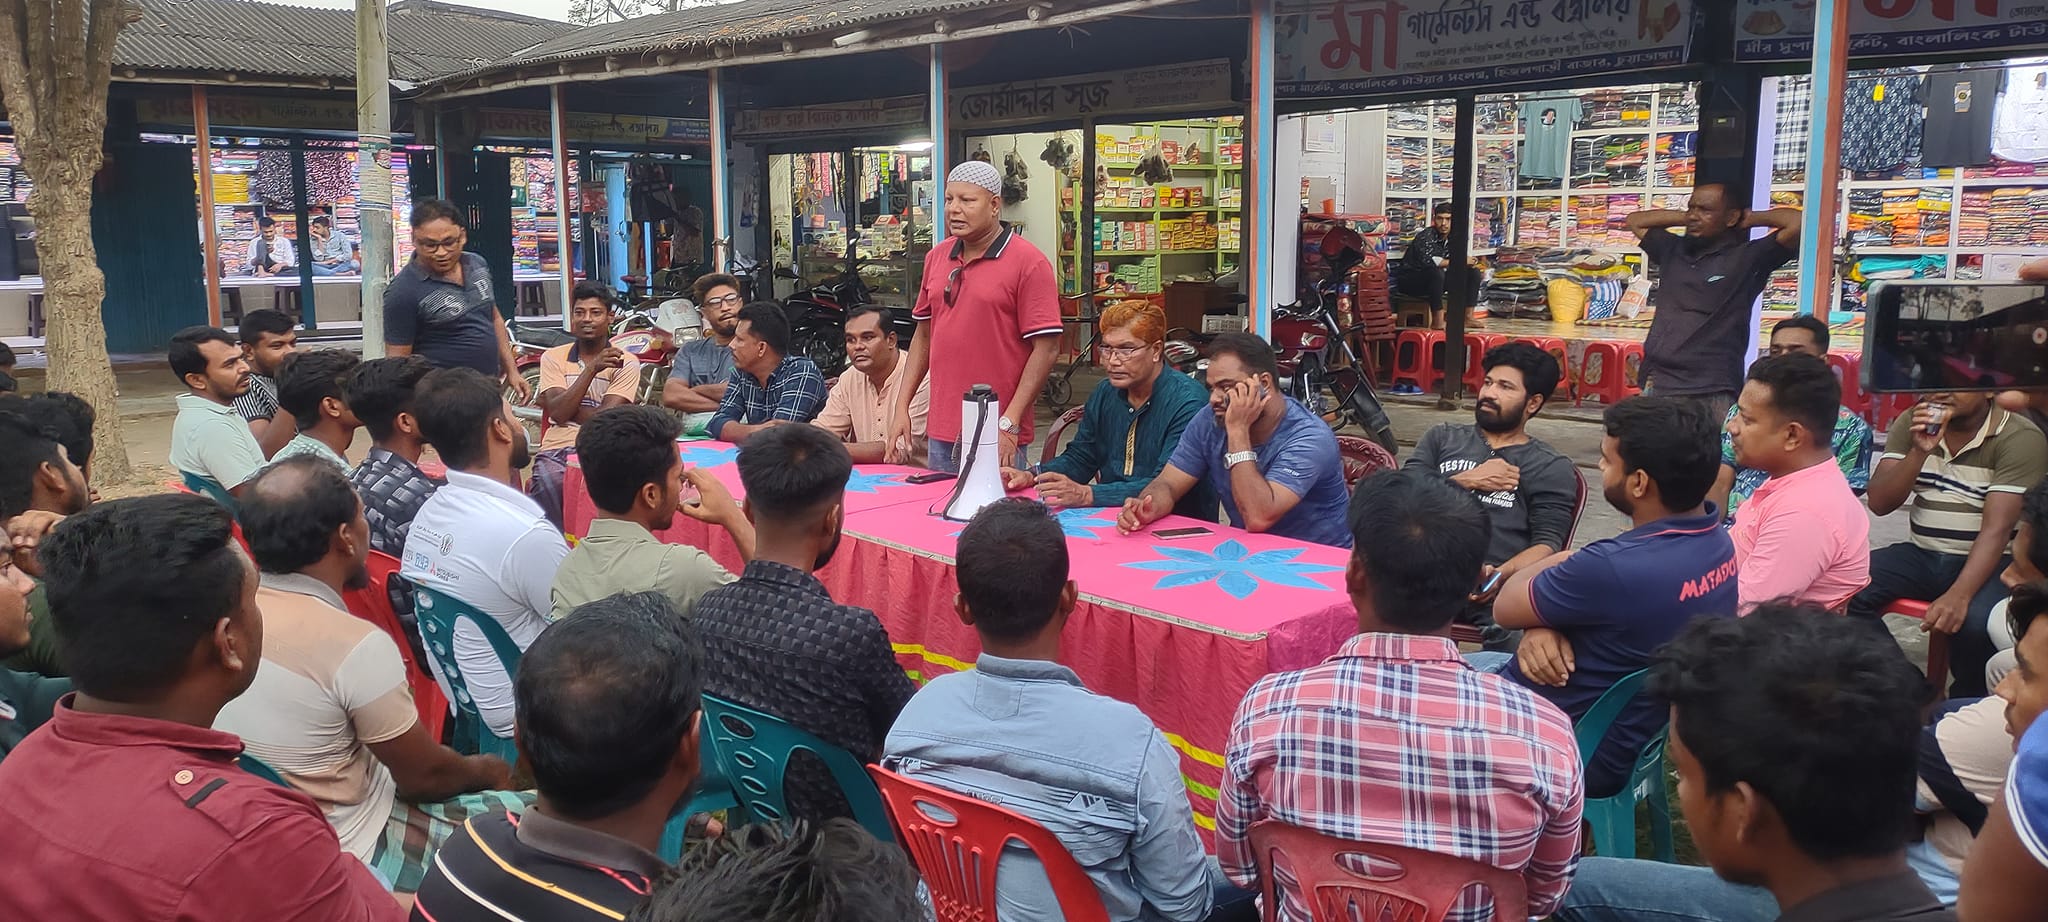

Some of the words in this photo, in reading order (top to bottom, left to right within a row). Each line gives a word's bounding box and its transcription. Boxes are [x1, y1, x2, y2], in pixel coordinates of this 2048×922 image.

[1317, 0, 1408, 72] মা
[1408, 0, 1493, 43] গার্মেন্টস
[1779, 40, 1811, 54] সুপা
[1848, 34, 1888, 50] র্কেট,
[1897, 29, 2000, 46] বাংলালিংক
[1062, 80, 1112, 113] সুজ
[1440, 459, 1477, 474] FESTIV
[1679, 557, 1737, 602] MATADO
